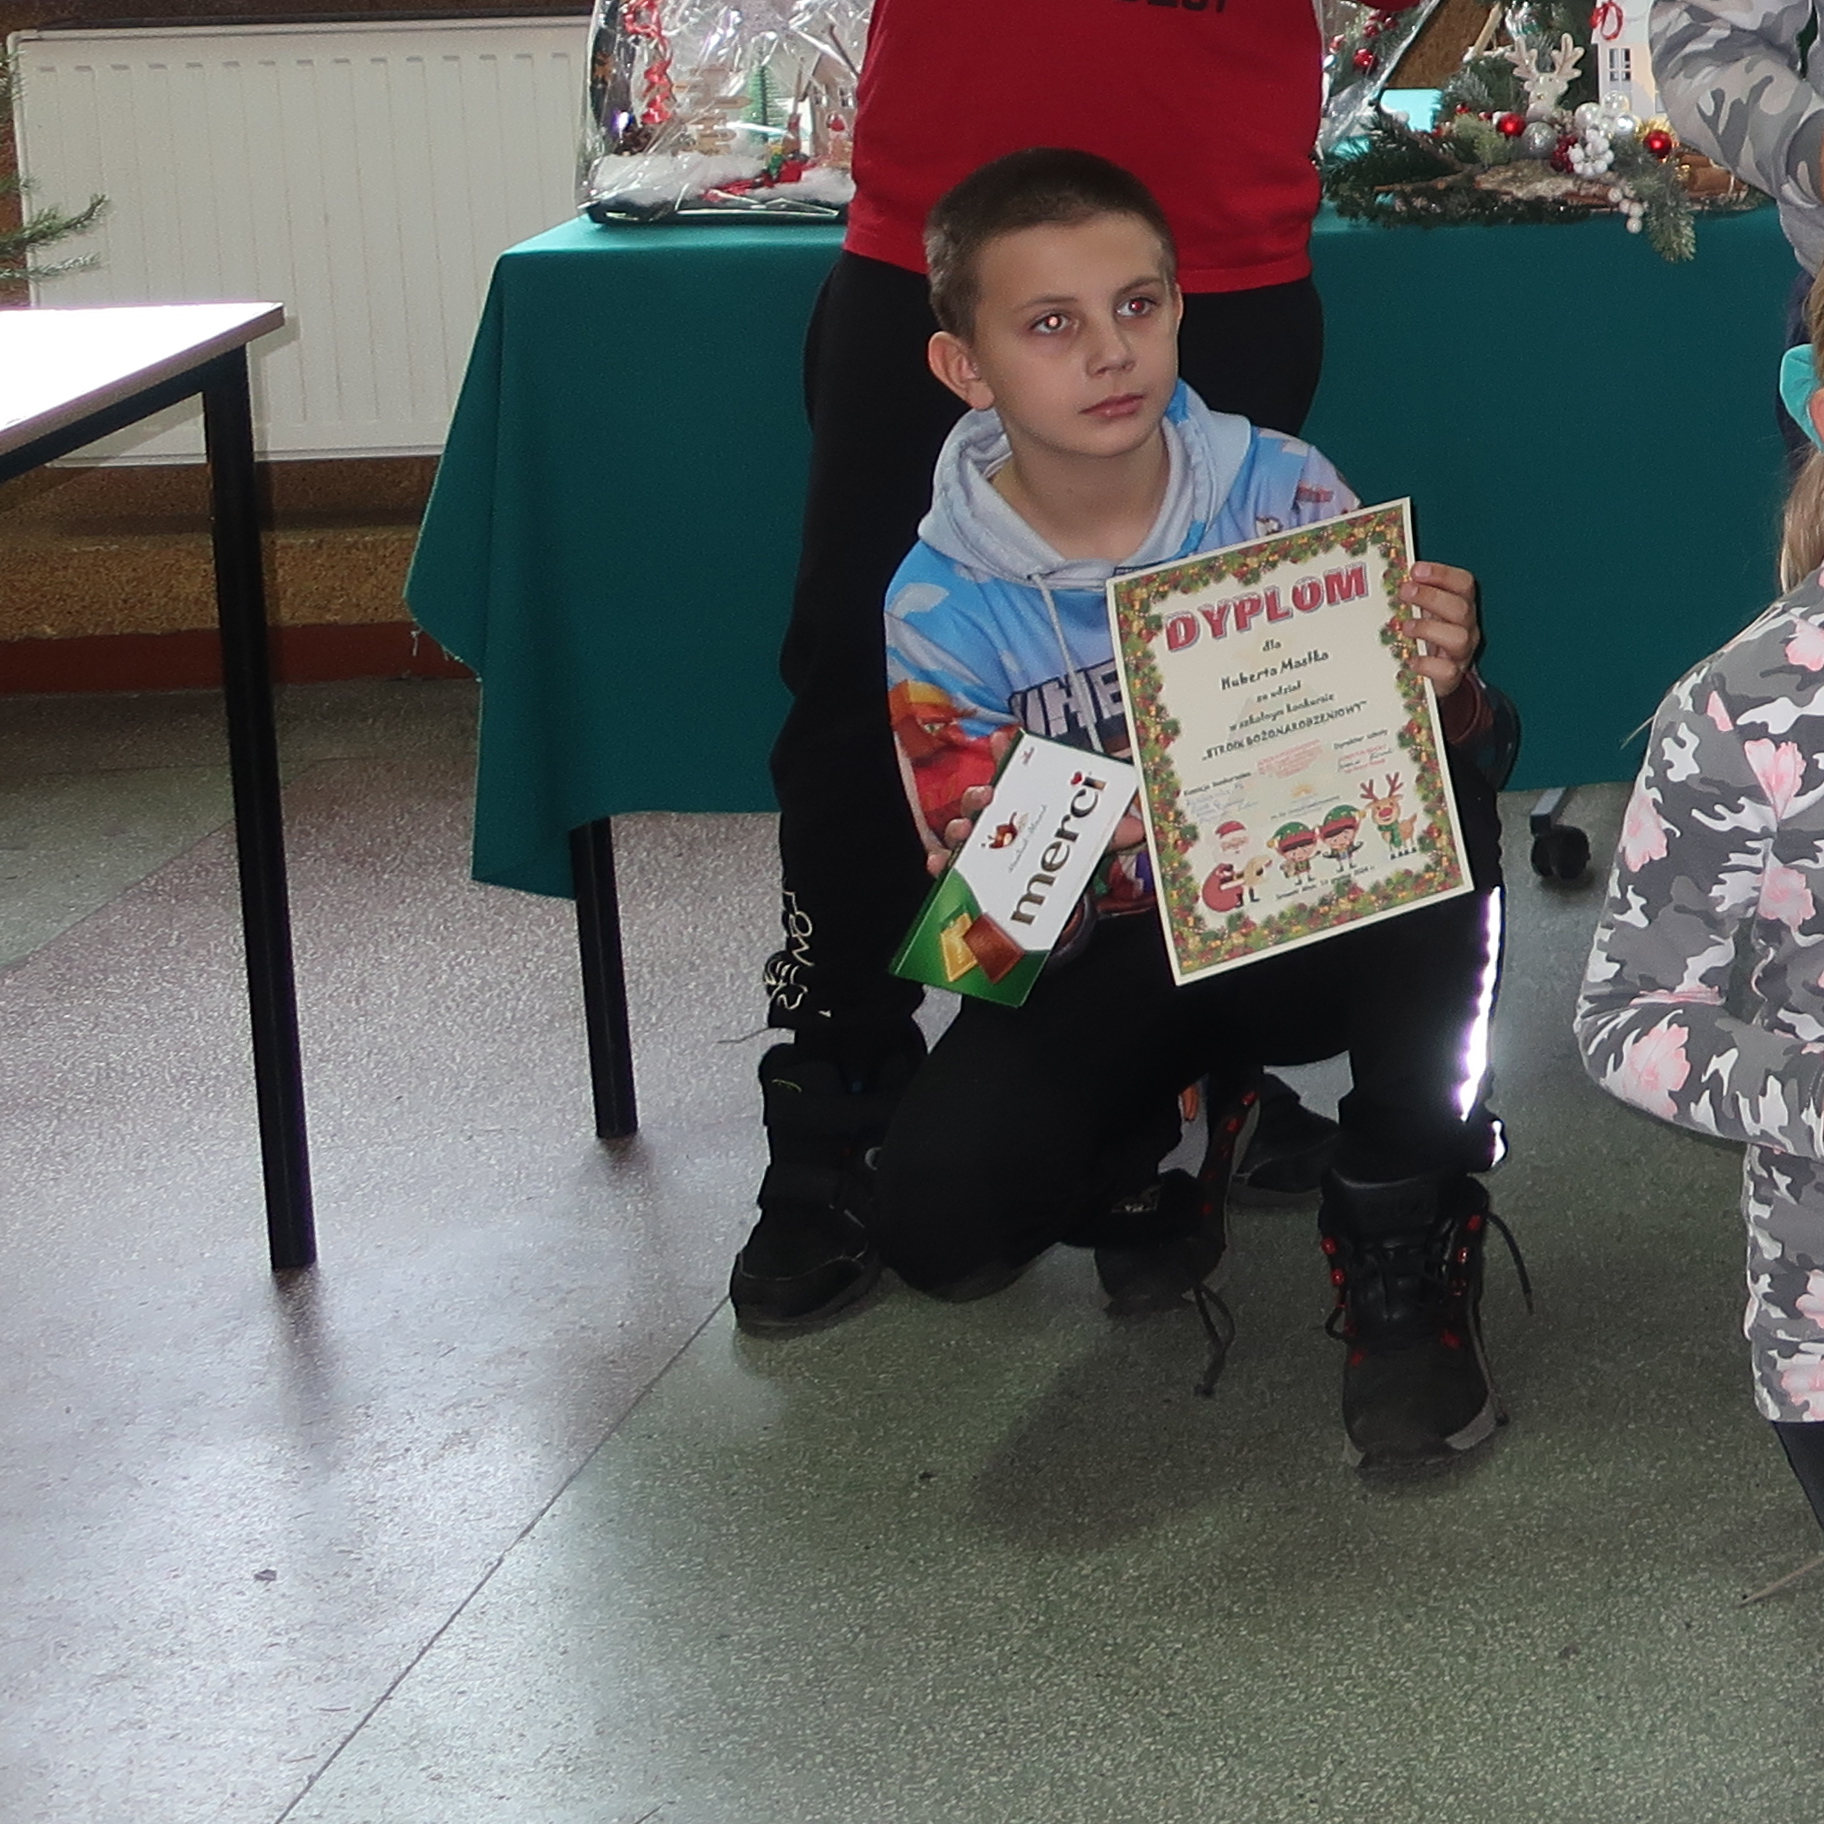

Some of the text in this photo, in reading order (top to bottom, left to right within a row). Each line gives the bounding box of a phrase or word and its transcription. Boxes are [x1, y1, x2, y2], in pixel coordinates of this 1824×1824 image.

[1164, 562, 1369, 652] DYPLOM
[1262, 638, 1282, 652] dla
[1221, 663, 1278, 690] Huberta
[1008, 771, 1108, 926] merci
